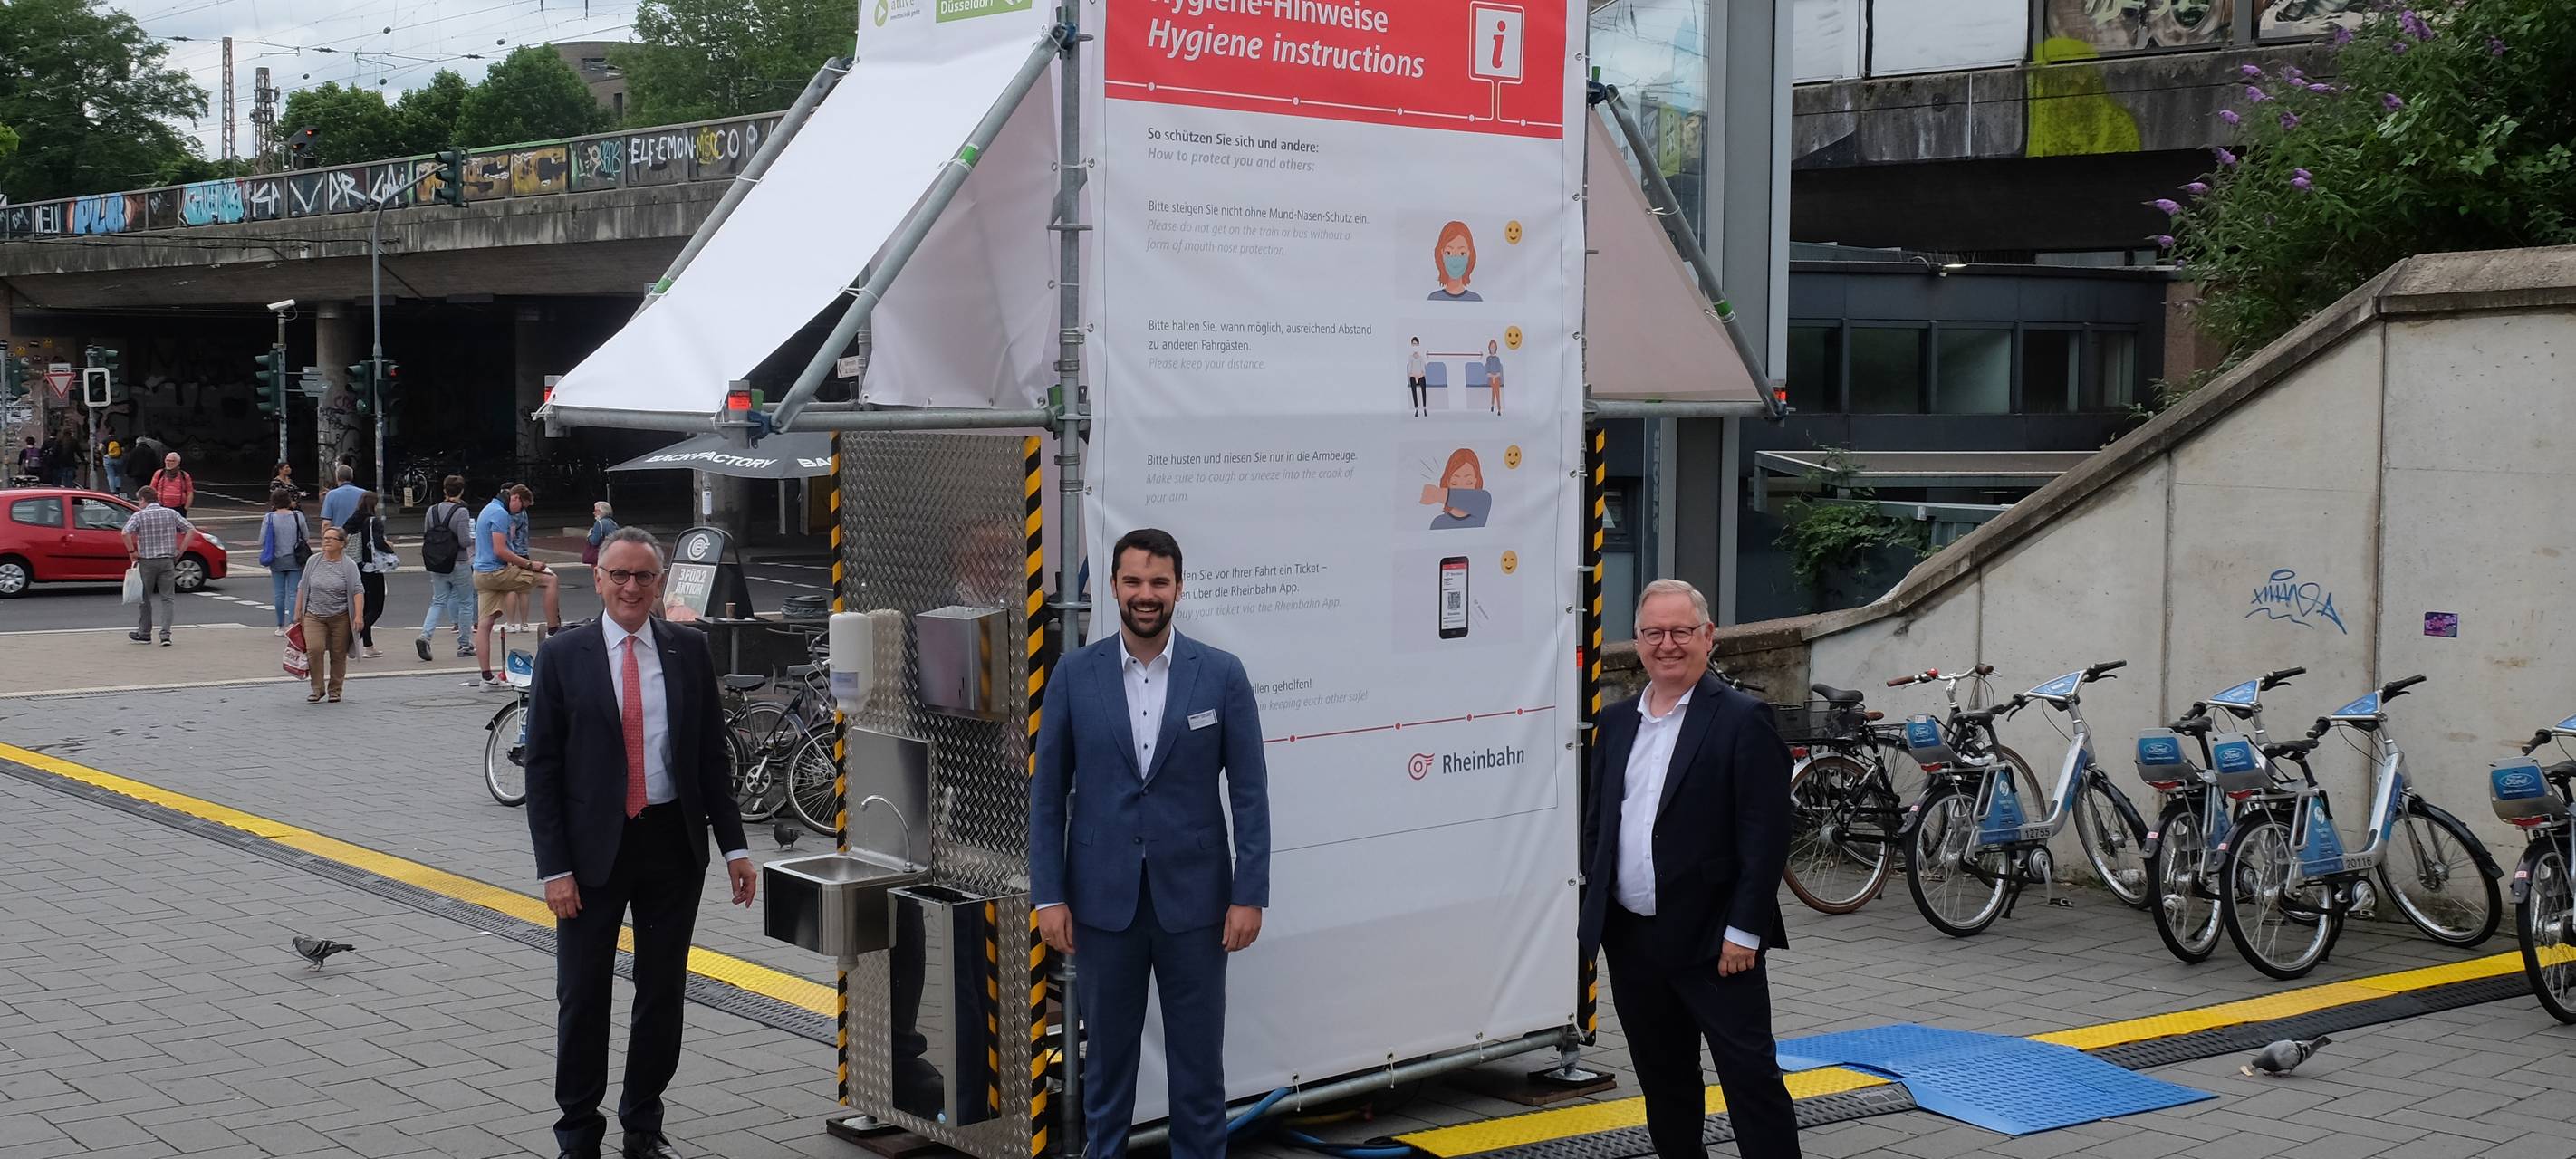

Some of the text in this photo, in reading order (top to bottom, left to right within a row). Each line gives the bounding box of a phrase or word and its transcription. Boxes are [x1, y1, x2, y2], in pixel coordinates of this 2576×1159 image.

[1151, 0, 1389, 33] gene-Hinweise
[1147, 18, 1425, 78] Hygiene instructions
[1148, 128, 1319, 153] So schützen Sie sich und andere:
[1148, 147, 1315, 172] How to protect you and others:
[1149, 200, 1370, 224] Bitte steigen Sie nicht ohne Mund-Nasen-Schutz ein.
[1147, 219, 1351, 241] Please do not get on the train or bus without a
[1146, 237, 1170, 253] form
[1172, 238, 1183, 254] of
[1149, 320, 1372, 336] Bitte halten Sie, wann möglich, ausreichend Abstand
[1149, 339, 1252, 353] zu anderen Fahrgästen.
[1149, 358, 1177, 369] Please
[1180, 358, 1203, 372] keep
[1205, 359, 1226, 373] your
[1147, 450, 1358, 465] Bitte husten und niesen Sie nur in die Armbeuge.
[1146, 466, 1355, 485] Make sure to cough or sneeze into the crook of
[1146, 493, 1167, 507] your
[1199, 569, 1212, 580] Sie
[1215, 570, 1229, 580] vor
[1232, 567, 1252, 578] Ihrer
[1254, 565, 1276, 577] Fahrt
[1279, 565, 1293, 576] ein
[1294, 562, 1320, 574] Ticket
[1193, 587, 1212, 599] über
[1215, 586, 1228, 598] die
[1231, 582, 1276, 597] Rheinbahn
[1279, 582, 1300, 594] App.
[1176, 608, 1192, 619] buy
[1195, 608, 1214, 620] your
[1216, 604, 1240, 616] ticket
[1242, 605, 1255, 614] via
[1257, 602, 1273, 613] the
[1274, 598, 1321, 611] Rheinbahn
[1253, 677, 1312, 694] llen geholfen!
[1269, 699, 1302, 711] keeping
[1303, 695, 1323, 706] each
[1325, 693, 1348, 704] other
[1442, 745, 1524, 774] Rheinbahn
[2025, 828, 2051, 838] 12755
[2346, 857, 2373, 869] 20116
